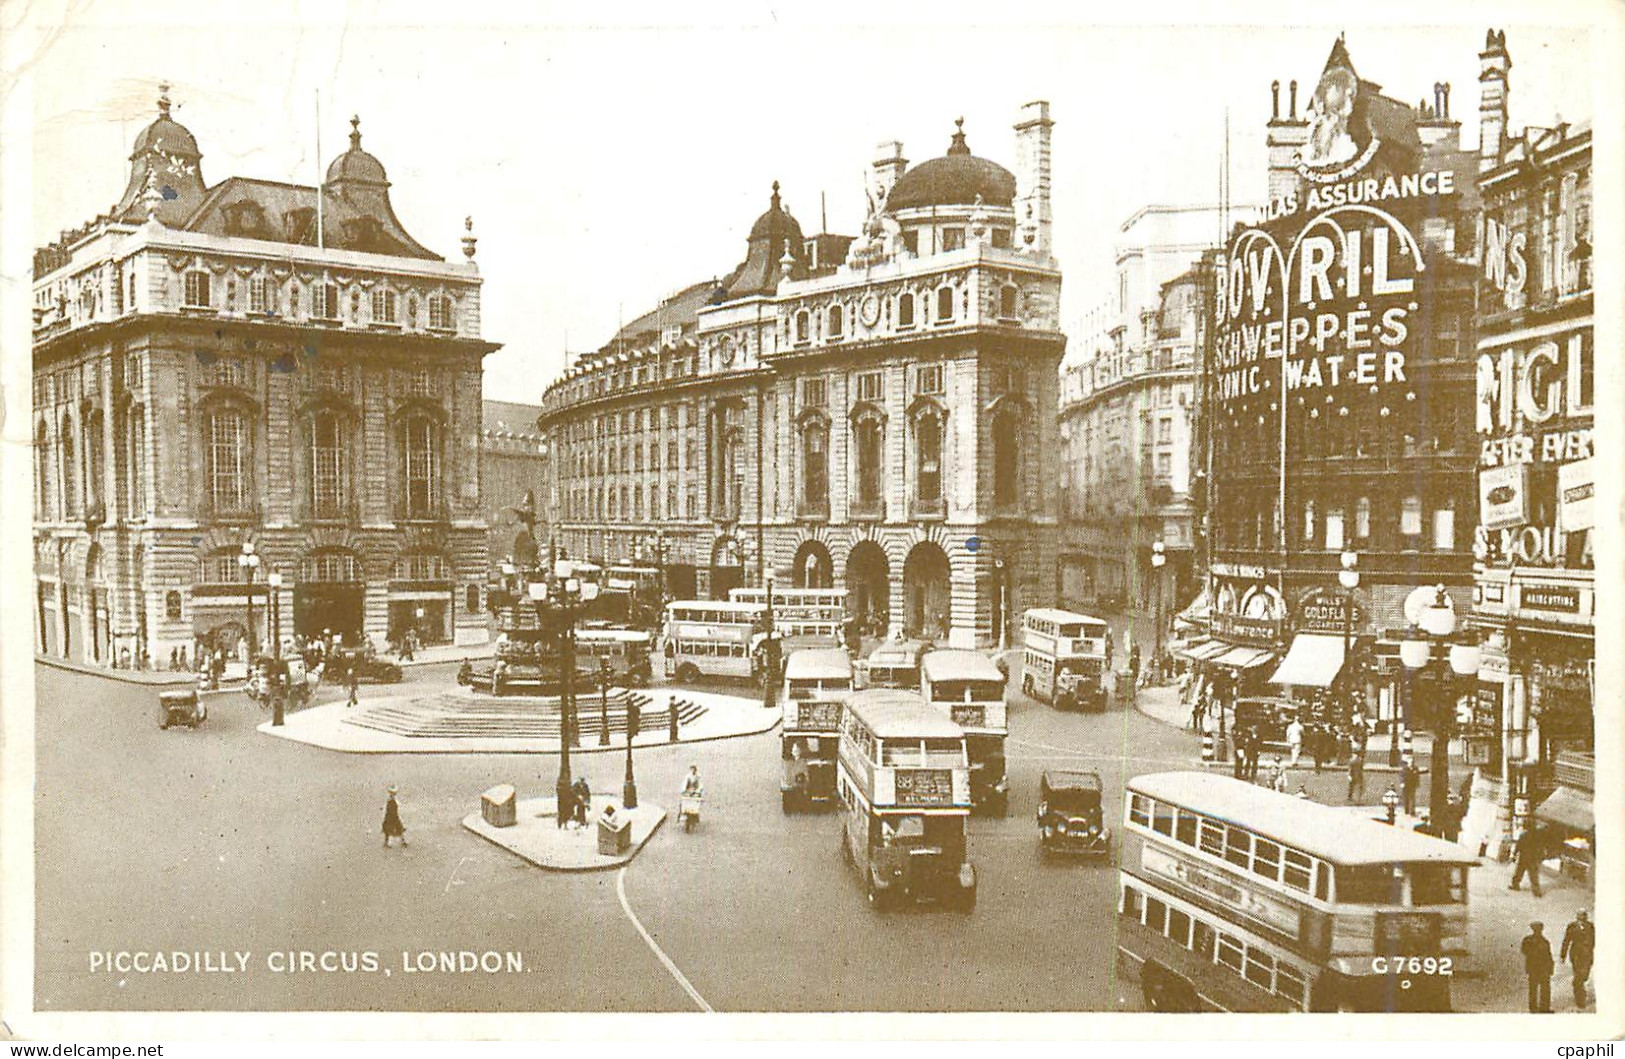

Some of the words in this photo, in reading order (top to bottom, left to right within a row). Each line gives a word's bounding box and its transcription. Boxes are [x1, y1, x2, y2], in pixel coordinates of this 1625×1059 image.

[1306, 170, 1455, 211] ASSURANCE
[1215, 227, 1414, 326] BOVRIL
[1215, 307, 1408, 369] SCHWEPPES
[1216, 366, 1260, 401] TONIC
[1286, 351, 1406, 390] WATER
[1304, 606, 1327, 619] GOLD
[1328, 607, 1360, 622] FLAE
